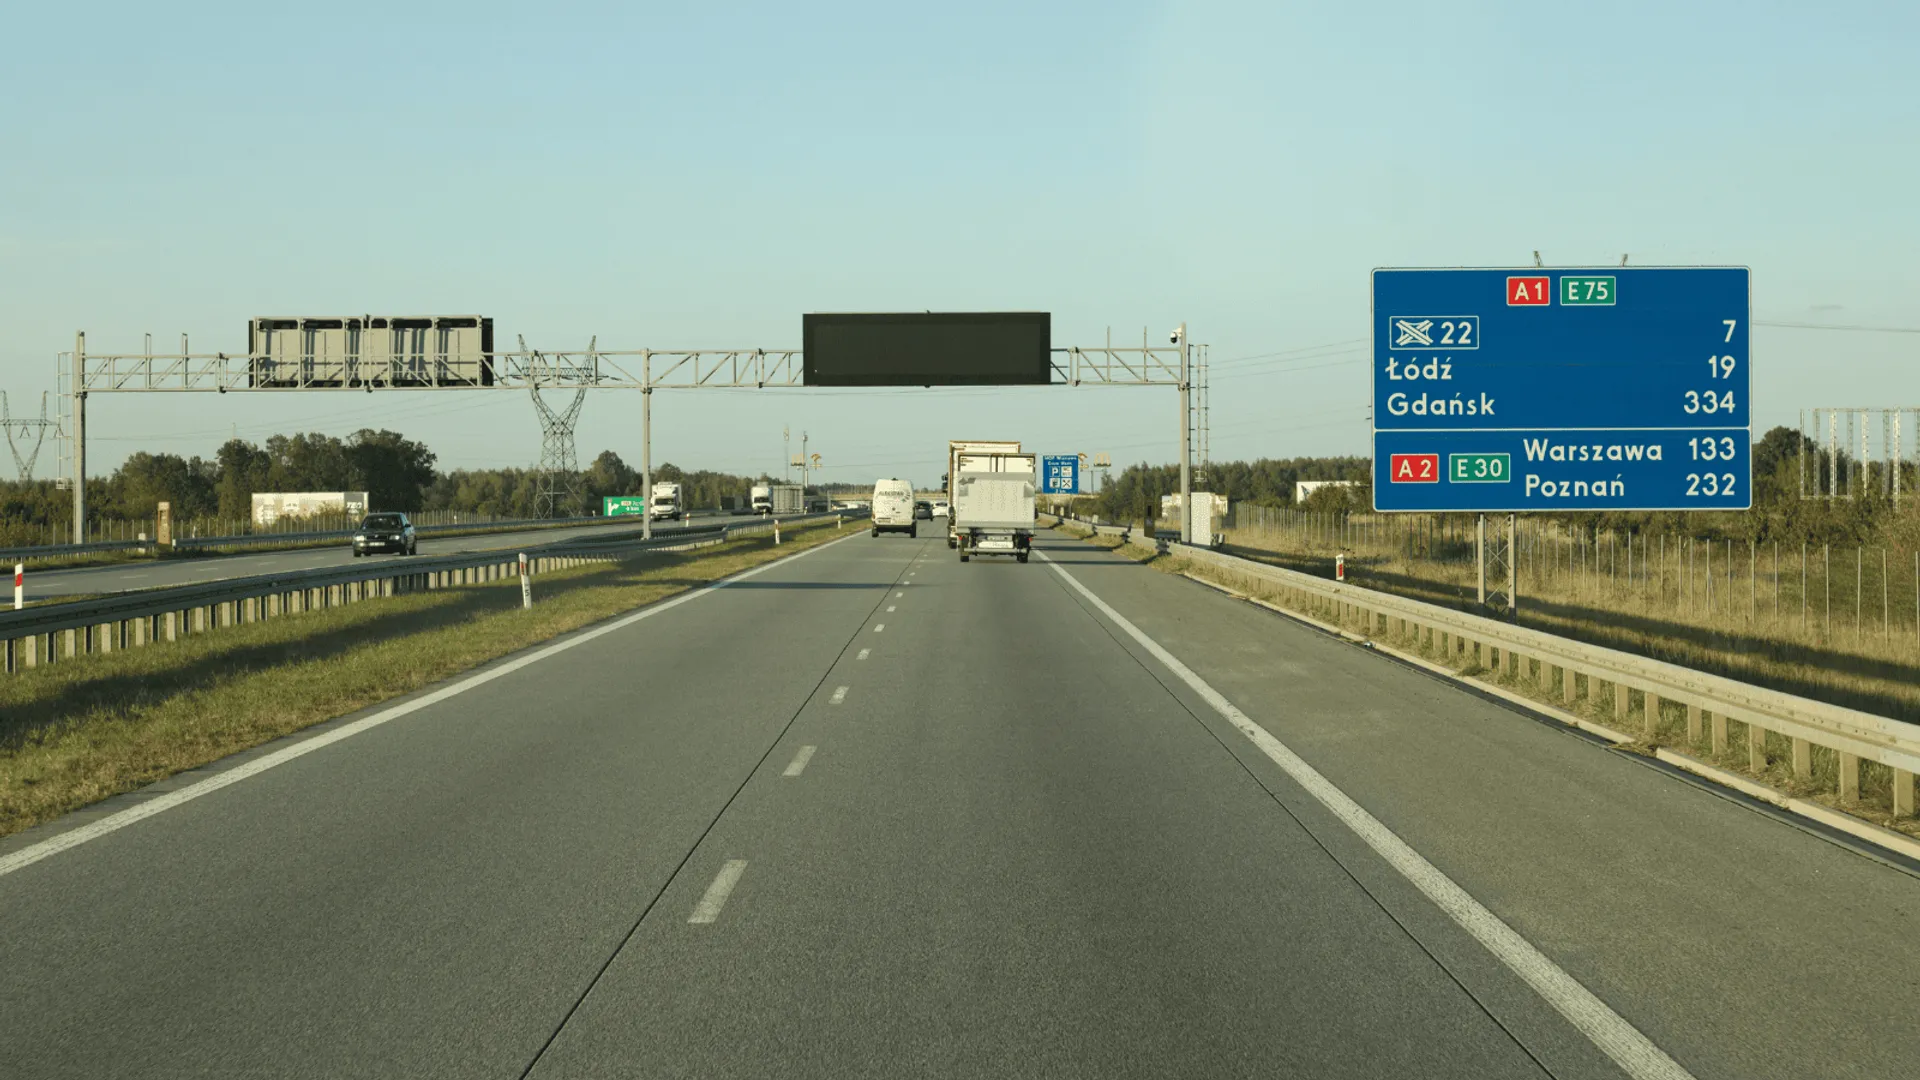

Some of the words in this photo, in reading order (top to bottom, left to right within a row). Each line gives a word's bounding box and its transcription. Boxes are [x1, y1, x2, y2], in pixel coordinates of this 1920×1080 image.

[1440, 321, 1472, 344] 22
[1723, 319, 1737, 343] 7
[1385, 357, 1452, 381] Łódź
[1708, 355, 1736, 379] 19
[1387, 392, 1495, 416] Gdańsk
[1683, 390, 1736, 414] 334
[1523, 438, 1662, 461] Warszawa
[1688, 436, 1736, 461] 133
[1525, 473, 1625, 497] Poznań
[1686, 472, 1736, 496] 232
